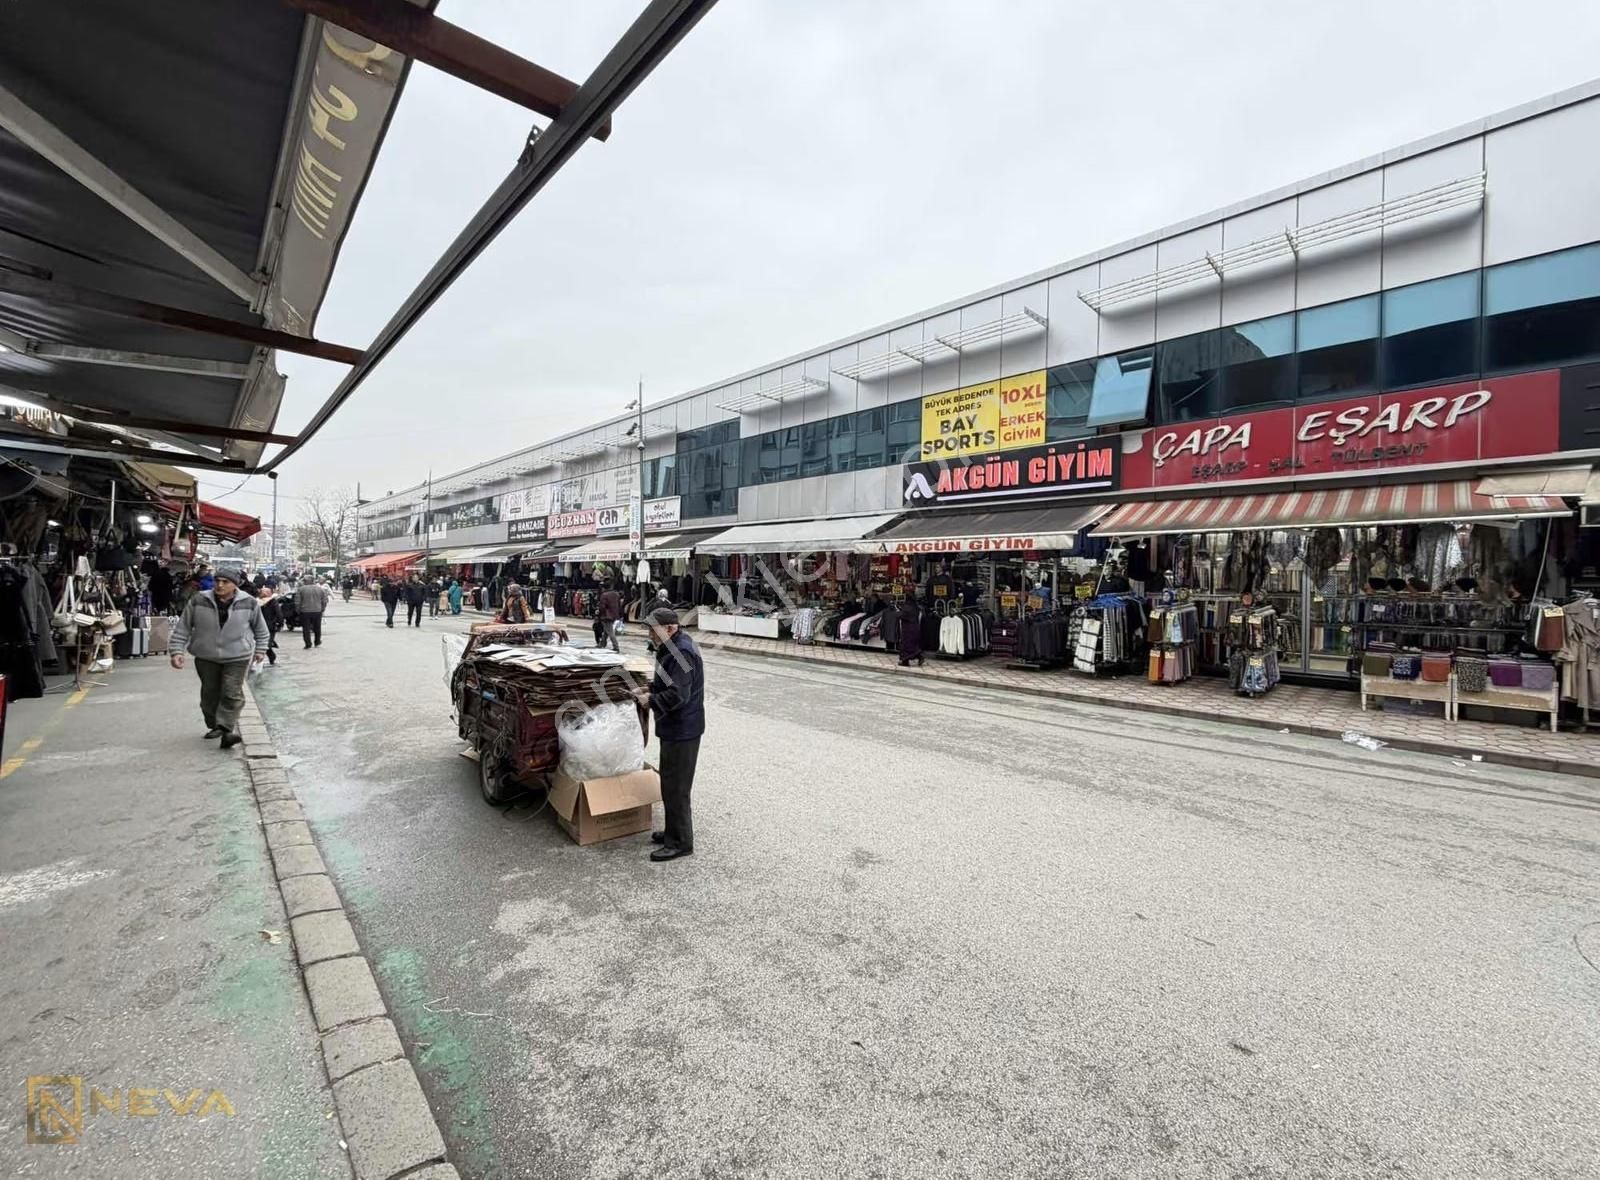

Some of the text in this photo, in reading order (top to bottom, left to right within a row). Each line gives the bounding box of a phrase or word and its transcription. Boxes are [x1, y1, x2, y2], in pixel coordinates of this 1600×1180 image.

[924, 387, 994, 409] BÜYÜK BEDENDE
[1001, 384, 1045, 405] 10XL
[936, 401, 982, 417] TEK ADRES
[1000, 411, 1045, 428] ERKEK
[940, 414, 977, 435] BAY
[1003, 427, 1041, 442] GİYİM
[1152, 390, 1493, 467] ÇAPA EŞARP
[922, 430, 995, 455] SPORTS
[937, 456, 1020, 493] AKGÜN
[1028, 443, 1113, 484] GİYİM
[895, 540, 961, 553] AKGÜN
[969, 537, 1035, 550] GİYİM
